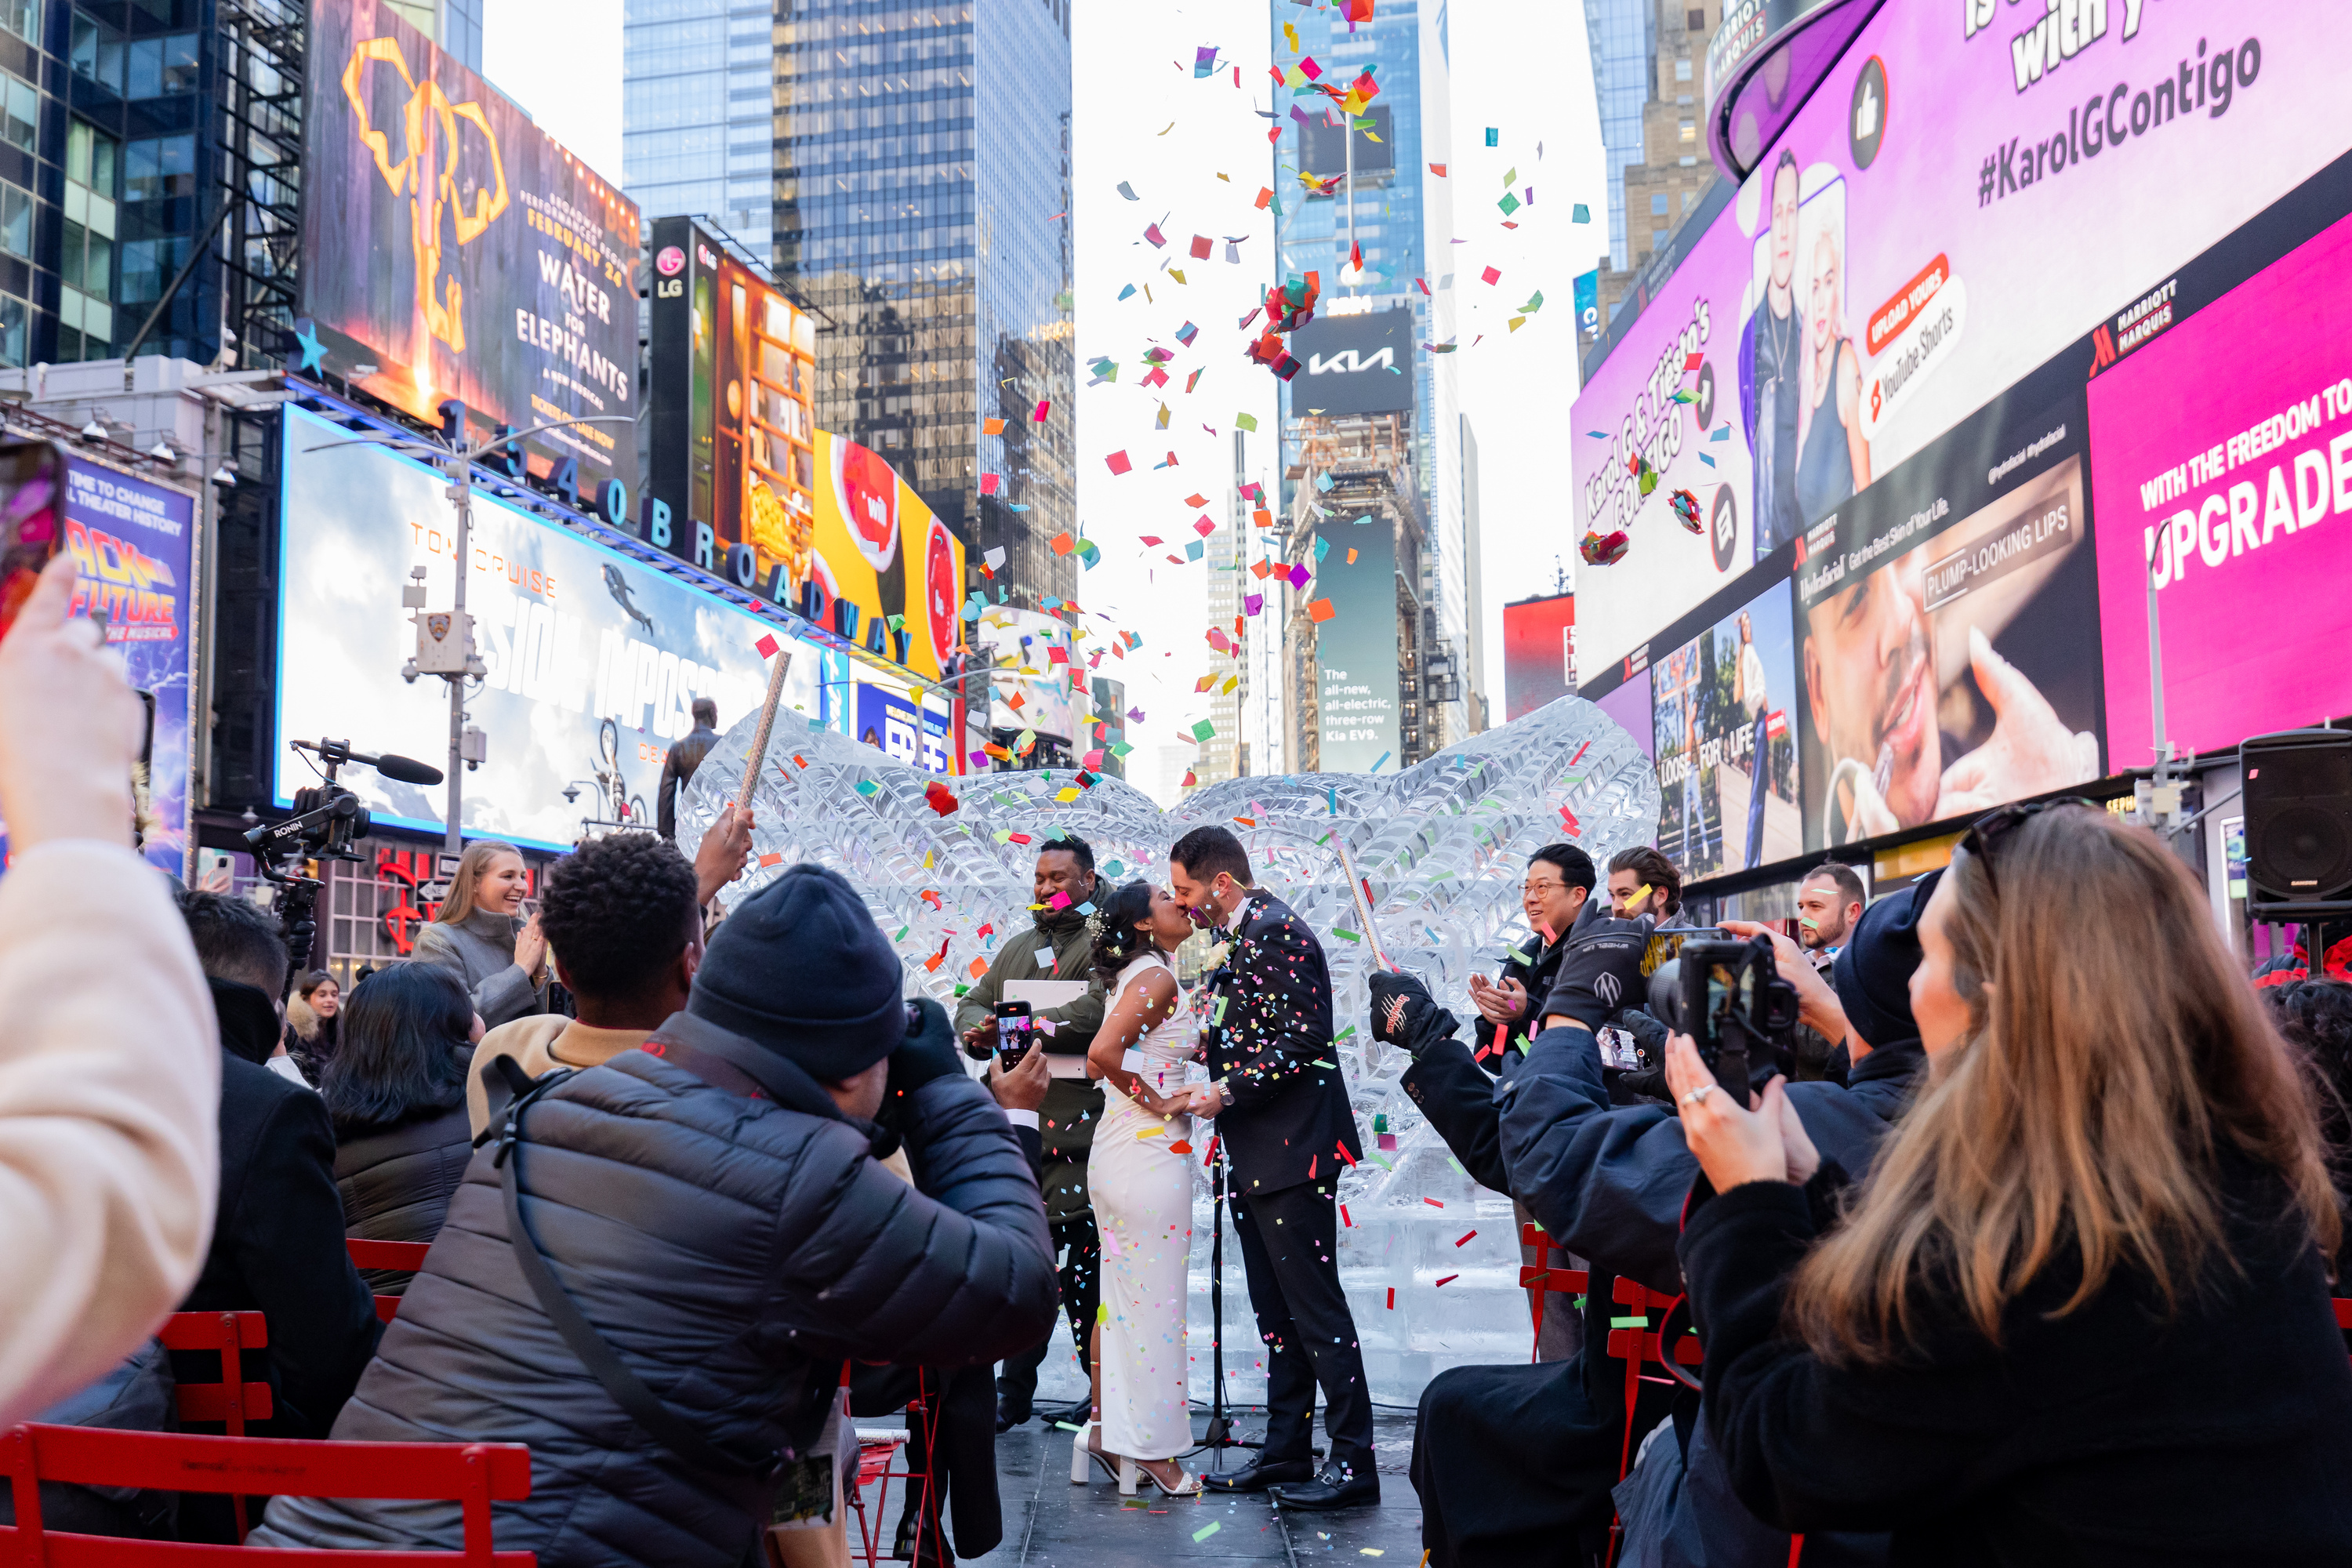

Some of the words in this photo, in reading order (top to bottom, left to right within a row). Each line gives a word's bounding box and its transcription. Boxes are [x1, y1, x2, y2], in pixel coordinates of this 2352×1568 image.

[2011, 0, 2111, 94] with
[1976, 36, 2263, 209] #KarolGContigo
[520, 190, 597, 247] PERFORMANCES
[550, 193, 603, 240] BROADWAY
[528, 208, 601, 267] FEBRUARY
[604, 261, 622, 289] 24
[538, 249, 611, 325] WATER
[658, 280, 683, 299] LG
[1871, 298, 1908, 344] UPLOAD
[1907, 267, 1943, 311] YOURS
[2118, 278, 2177, 332] MARRIOTT
[565, 311, 586, 338] FOR
[2118, 306, 2172, 352] MARQUIS
[516, 307, 629, 402] ELEPHANTS
[1882, 347, 1918, 403] YouTube
[1919, 307, 1953, 361] Shorts
[551, 369, 570, 387] NEW
[570, 380, 604, 411] MUSICAL
[1584, 437, 1620, 527] Karol
[1621, 414, 1634, 465] G
[1634, 393, 1648, 445] &
[2140, 463, 2187, 512] WITH
[2187, 443, 2225, 488] THE
[2227, 394, 2320, 471] FREEDOM
[78, 492, 132, 521] THEATER
[132, 506, 183, 537] HISTORY
[99, 479, 115, 499] TO
[117, 481, 165, 517] CHANGE
[65, 515, 154, 590] ACK
[476, 549, 557, 599] CRUISE
[1927, 524, 2033, 599] PLUMP-LOOKING
[2034, 504, 2069, 543] LIPS
[67, 577, 176, 624] FUTURE
[1324, 669, 1348, 681] The
[1324, 684, 1371, 696] all-new,
[1325, 714, 1385, 726] three-row
[1326, 731, 1347, 742] Kia
[1349, 729, 1379, 742] EV9.
[1661, 750, 1692, 789] LOOSE
[1699, 737, 1722, 770] FOR
[1730, 721, 1755, 759] LIFE
[274, 820, 304, 838] RONIN
[1582, 943, 1595, 953] UP
[1385, 993, 1410, 1033] SnowPaws
